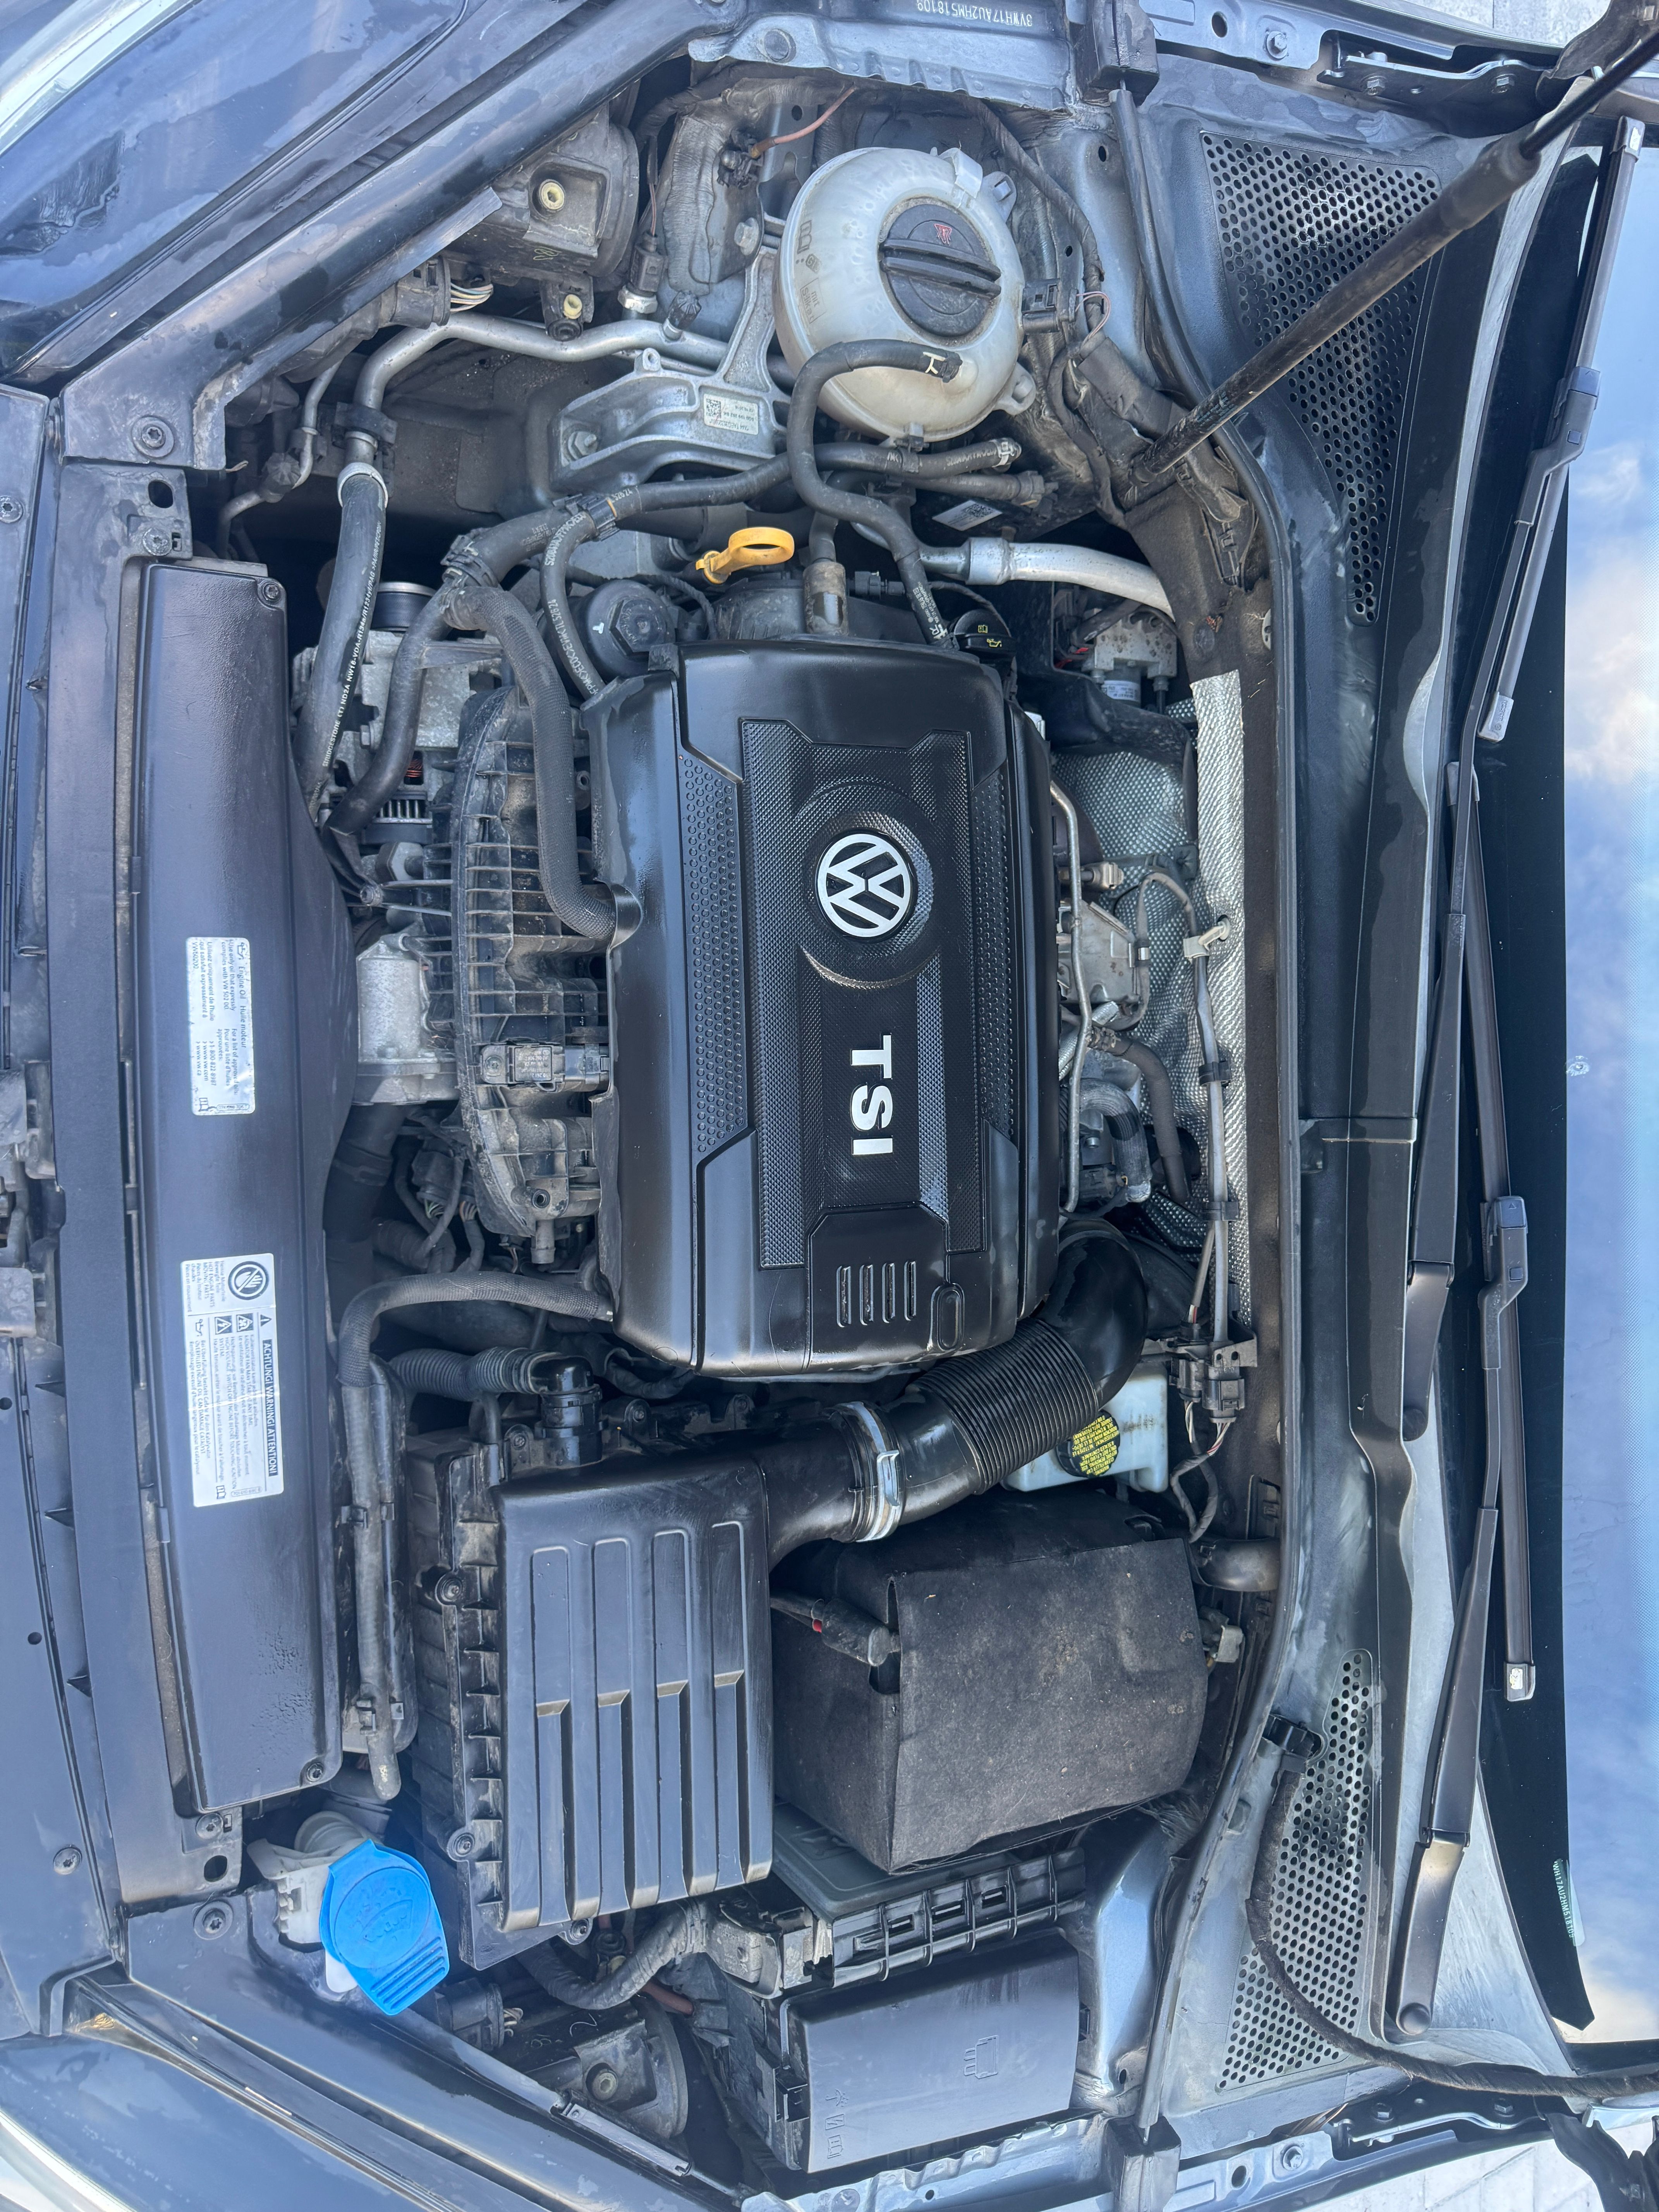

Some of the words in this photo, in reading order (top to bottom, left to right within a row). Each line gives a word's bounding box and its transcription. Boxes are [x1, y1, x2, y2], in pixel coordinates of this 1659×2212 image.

[341, 684, 350, 705] ND2A
[223, 980, 228, 989] VW
[236, 965, 246, 988] Engine
[850, 1034, 894, 1156] TSI
[1553, 1861, 1575, 1937] WH17AU2HM518109
